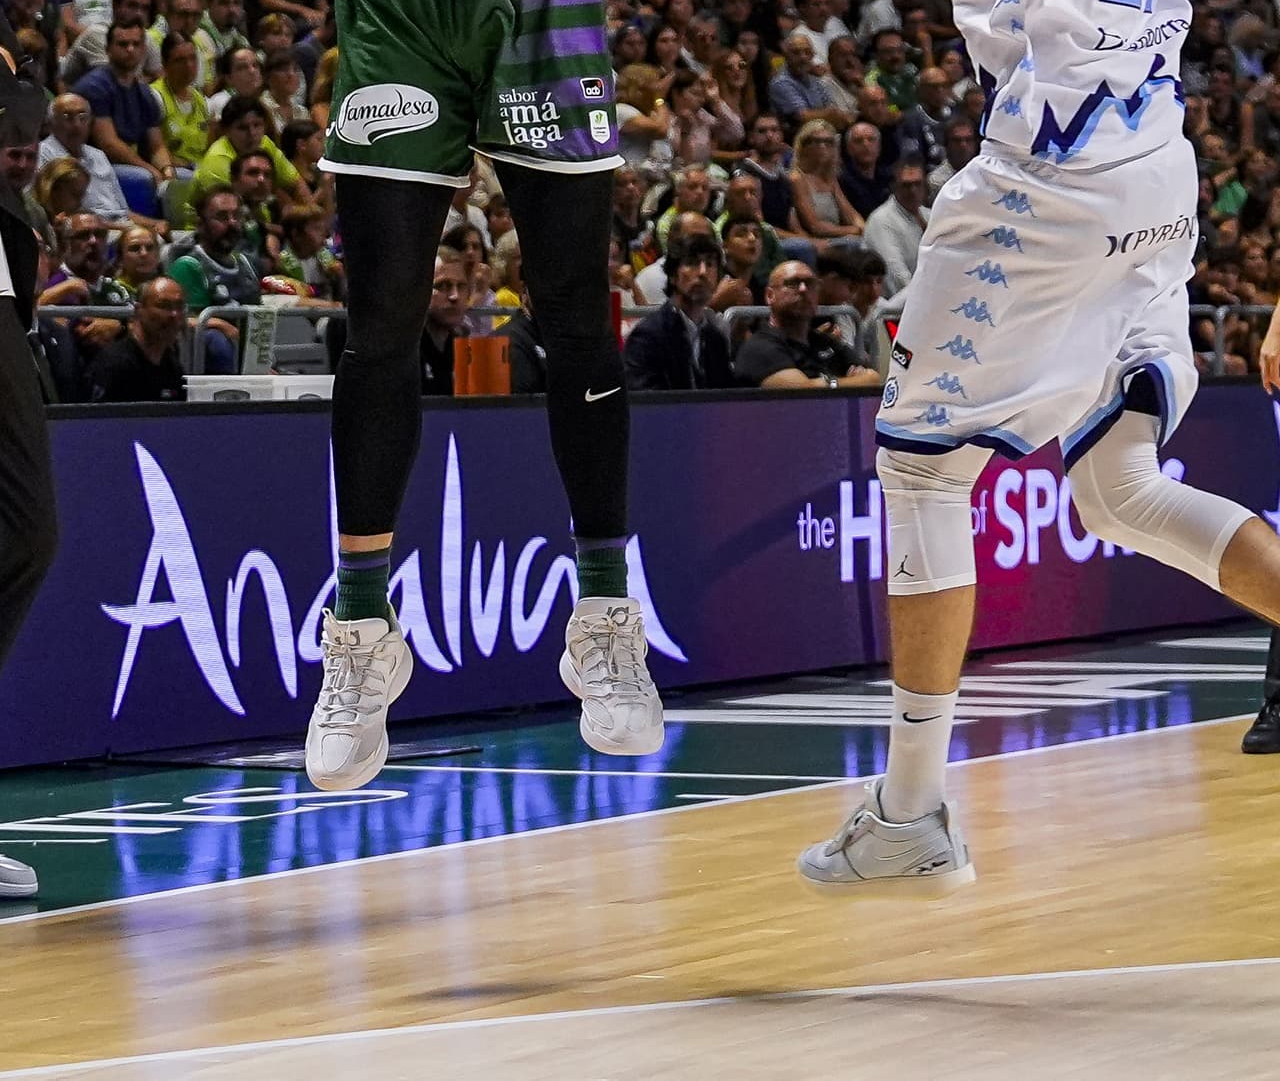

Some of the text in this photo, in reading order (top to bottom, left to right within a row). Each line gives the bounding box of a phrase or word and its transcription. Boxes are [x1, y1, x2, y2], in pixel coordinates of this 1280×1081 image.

[339, 87, 434, 131] famadesa
[499, 89, 538, 104] sabor
[500, 92, 561, 124] a má
[502, 120, 564, 148] laga
[796, 502, 836, 551] the
[994, 458, 1185, 570] SPO
